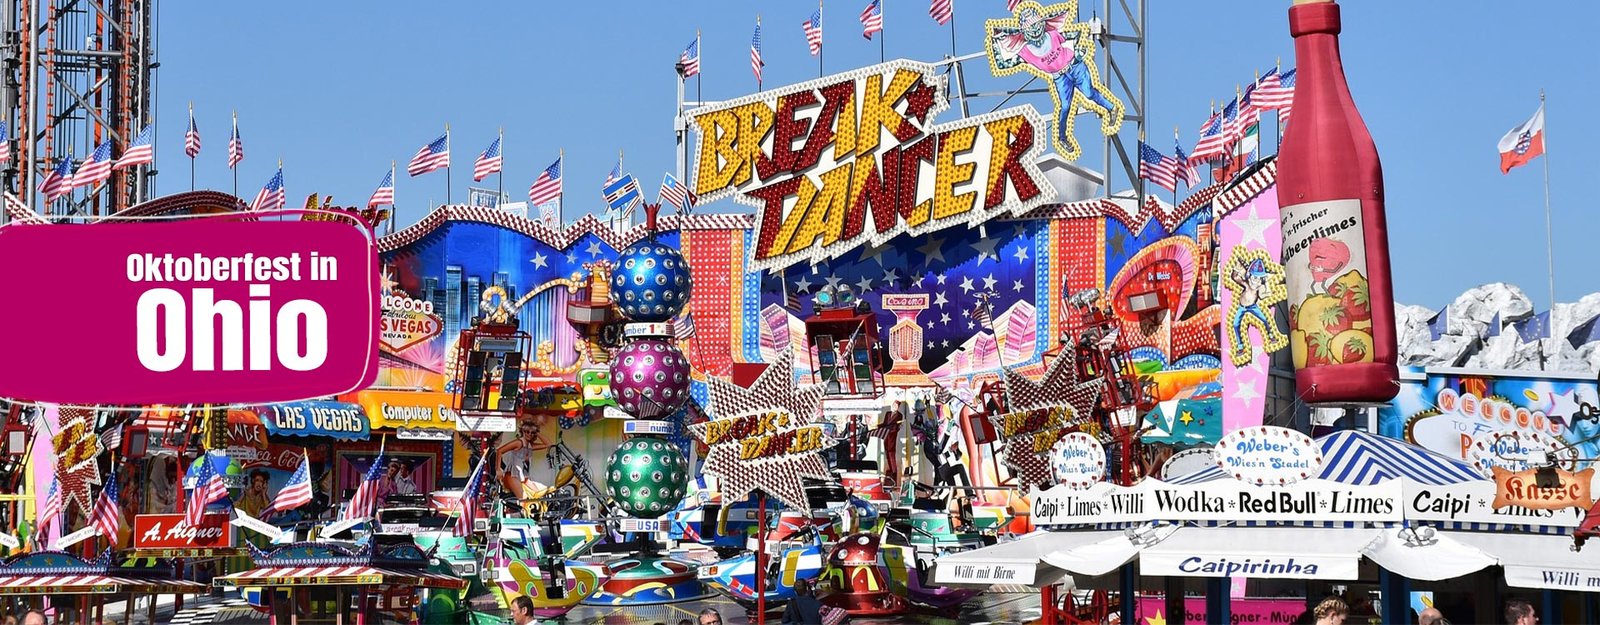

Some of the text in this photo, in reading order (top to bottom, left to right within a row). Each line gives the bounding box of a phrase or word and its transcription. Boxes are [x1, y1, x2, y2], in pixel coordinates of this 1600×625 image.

[694, 68, 924, 196] BREAK
[745, 114, 1041, 262] DANCER
[887, 297, 924, 306] Casino
[391, 319, 432, 334] VEGAS
[272, 405, 362, 432] LAS VEGAS
[381, 402, 432, 425] Computer
[1441, 393, 1560, 434] WELCOME
[1452, 420, 1467, 431] TO
[705, 411, 777, 446] BREAK
[740, 426, 823, 460] DANCER
[1236, 438, 1301, 456] Weber's
[1227, 457, 1309, 469] Wies'n Stadel
[1505, 476, 1580, 501] Kasse
[1034, 493, 1144, 523] Caipi Limes Willi
[1154, 489, 1394, 515] Wodka Red Bull Limes
[1413, 490, 1471, 520] Caipi
[142, 521, 161, 542] A.
[164, 519, 223, 545] Aigner
[638, 520, 659, 531] USA
[954, 565, 1016, 580] Willi mit Birne
[1178, 556, 1319, 577] Caipirinha
[1542, 570, 1580, 586] Willi
